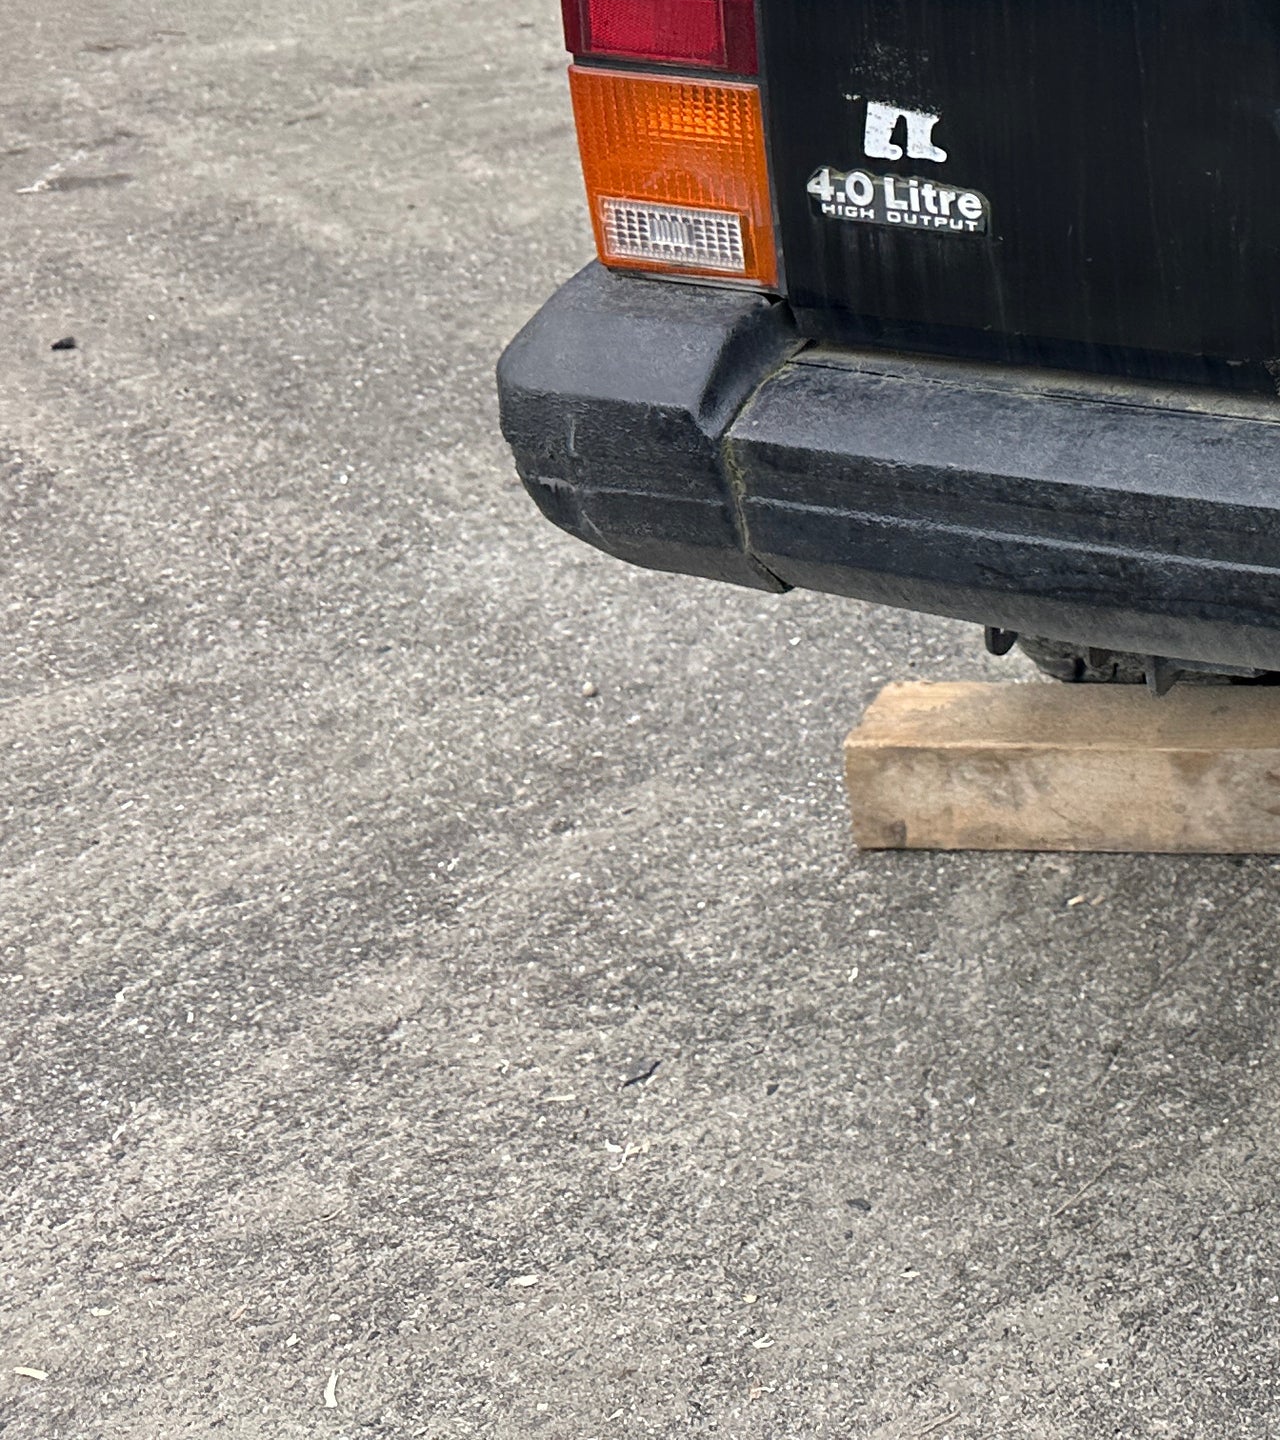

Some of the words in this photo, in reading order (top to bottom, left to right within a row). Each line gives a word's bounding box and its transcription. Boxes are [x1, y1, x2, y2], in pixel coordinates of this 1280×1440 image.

[806, 168, 874, 207] 4.0
[883, 176, 983, 220] Litre
[821, 203, 875, 220] HIGH
[886, 210, 979, 232] OUTPUT
